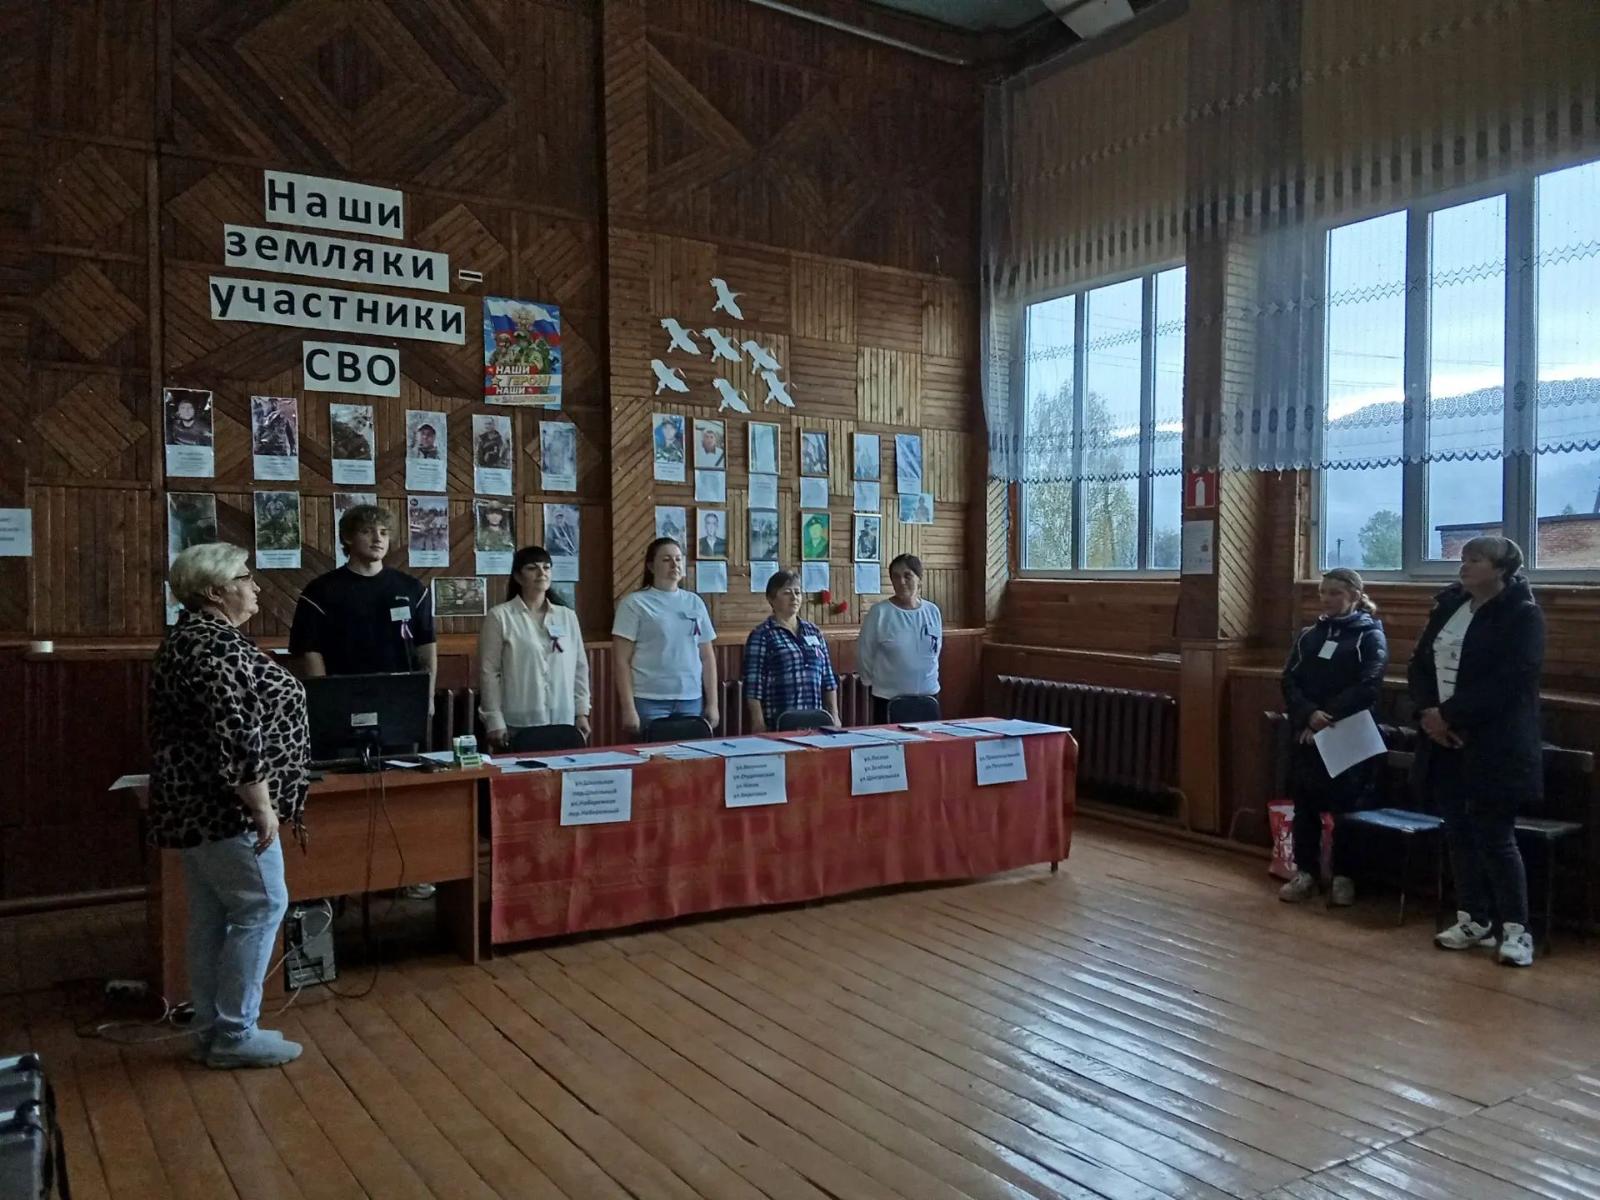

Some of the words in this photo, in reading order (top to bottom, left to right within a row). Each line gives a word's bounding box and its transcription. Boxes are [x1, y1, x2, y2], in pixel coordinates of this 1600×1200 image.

[267, 178, 401, 229] Наши
[226, 231, 434, 281] земляки
[211, 283, 462, 334] участники
[305, 348, 397, 386] СВО
[495, 365, 530, 374] НАШИ
[495, 386, 526, 395] НАШИ
